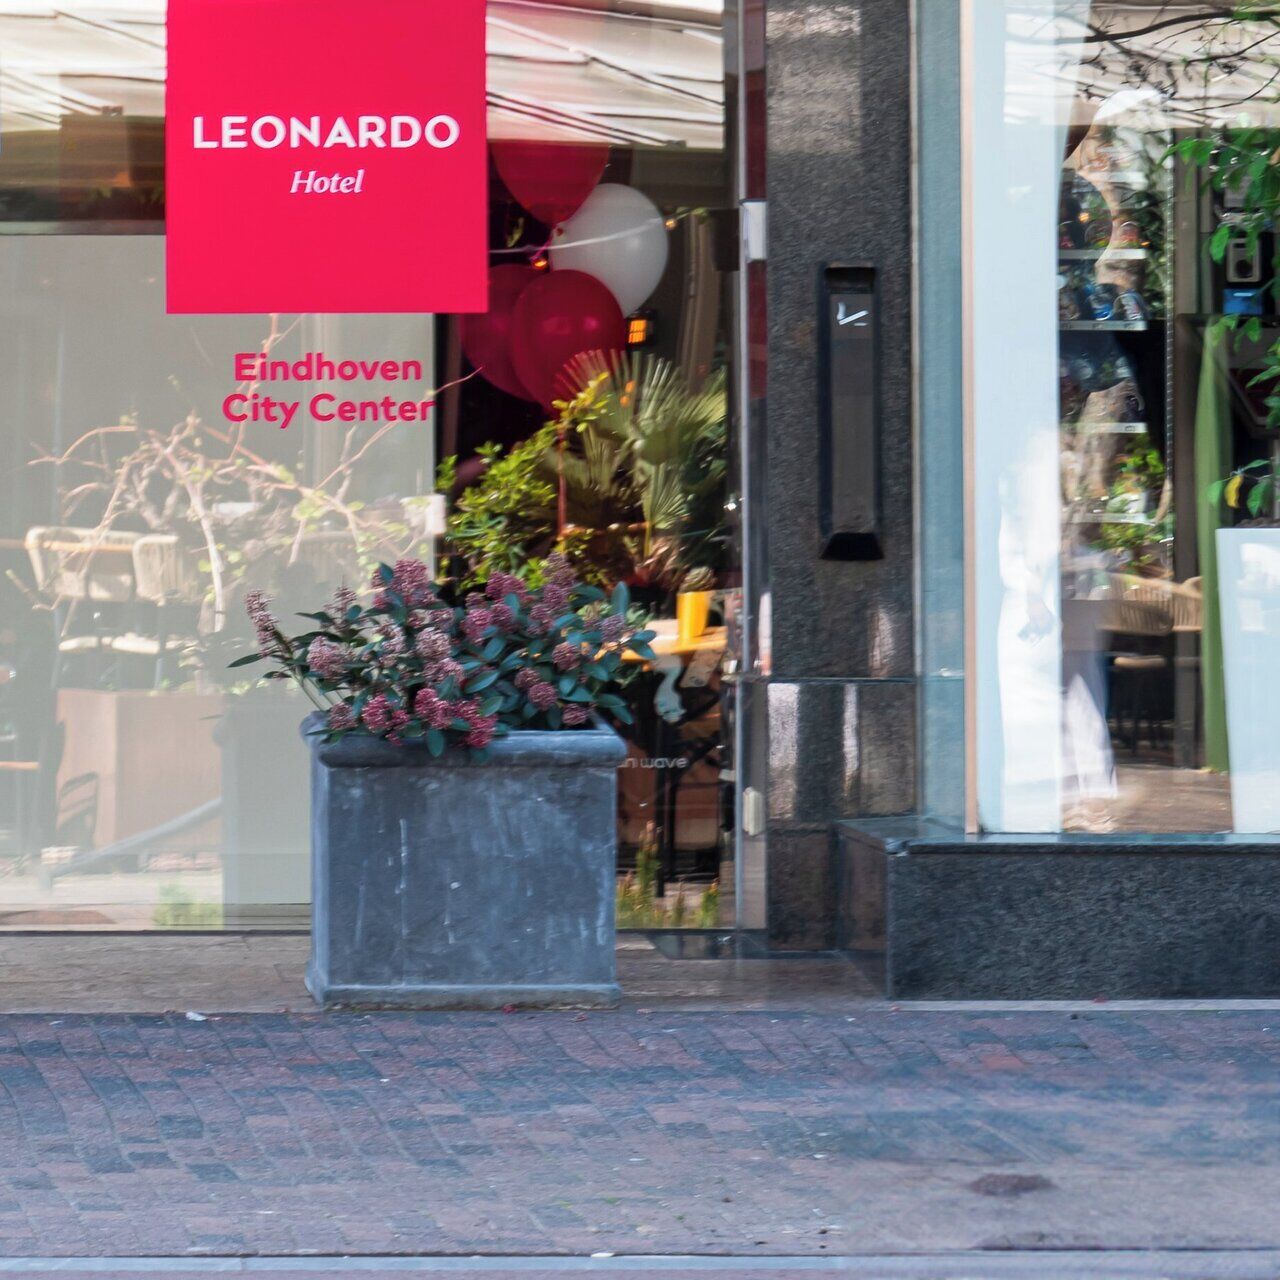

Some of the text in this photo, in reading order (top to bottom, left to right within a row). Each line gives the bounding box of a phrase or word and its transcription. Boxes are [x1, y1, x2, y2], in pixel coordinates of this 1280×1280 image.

[193, 114, 461, 149] LEONARDO
[289, 169, 365, 194] Hotel
[234, 352, 423, 381] Eindhoven
[222, 393, 437, 429] City Center
